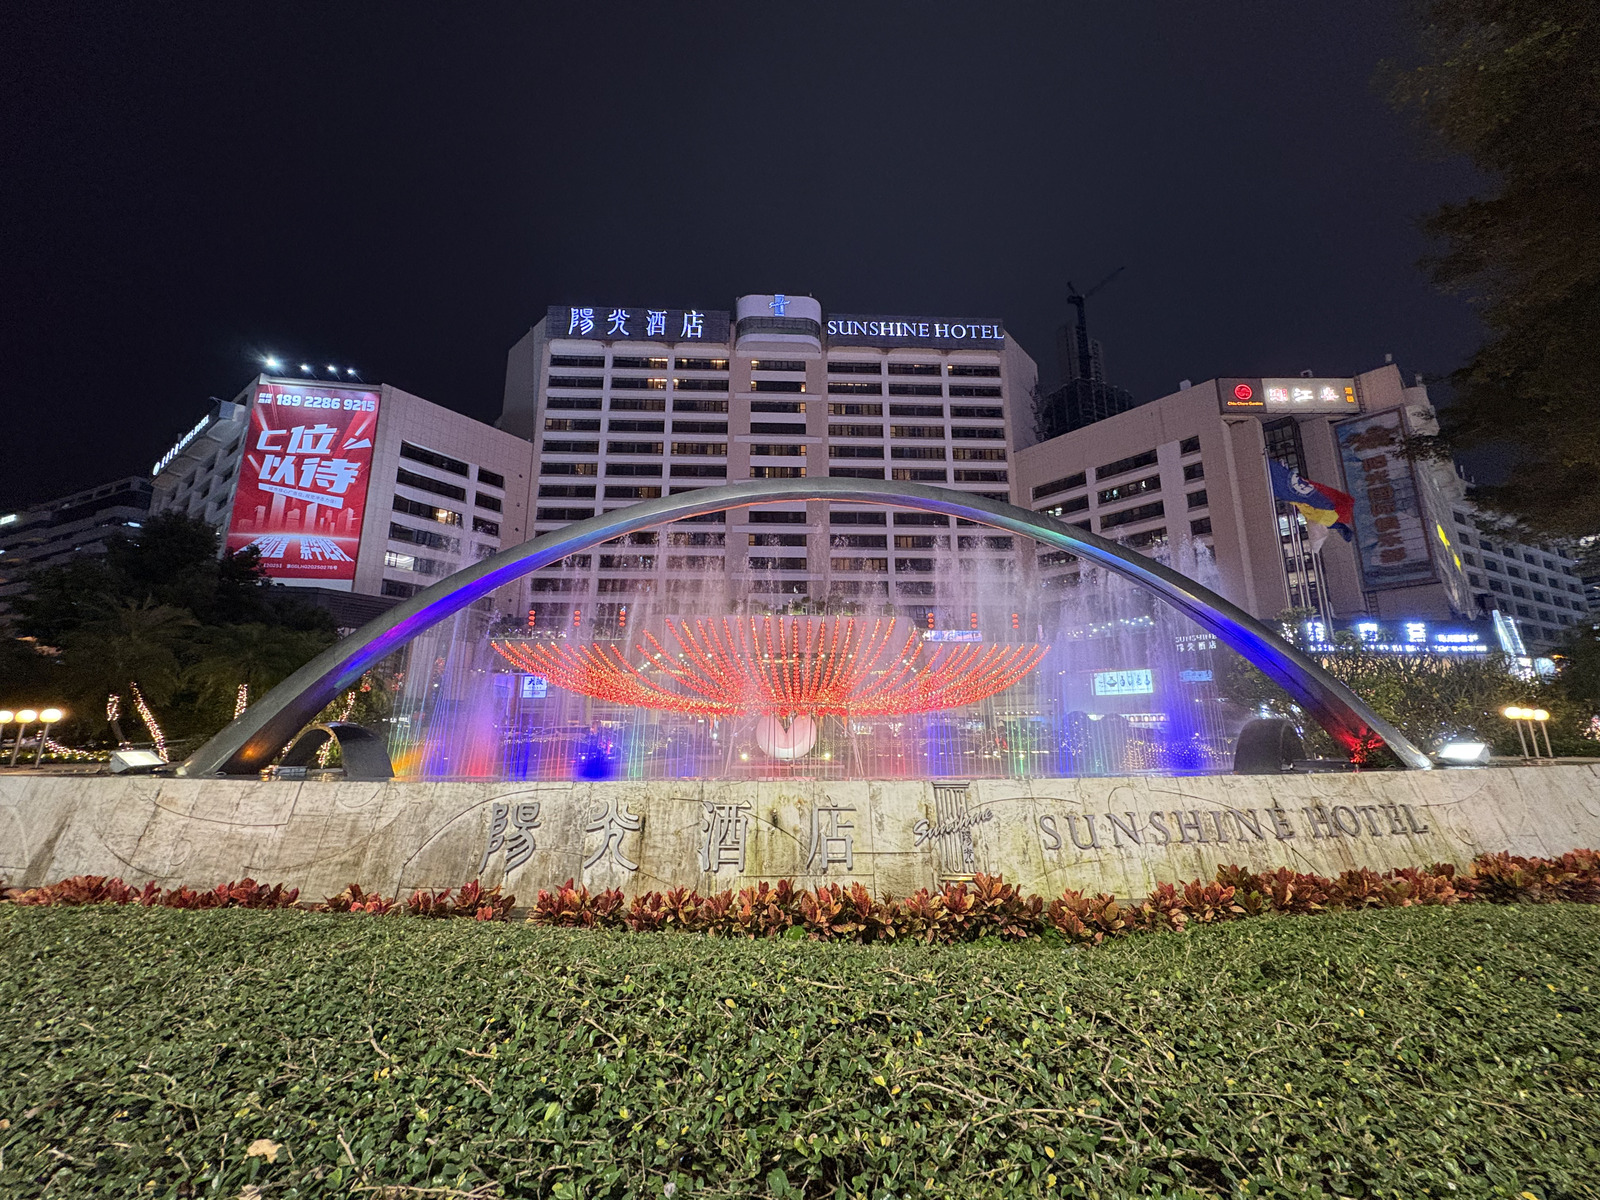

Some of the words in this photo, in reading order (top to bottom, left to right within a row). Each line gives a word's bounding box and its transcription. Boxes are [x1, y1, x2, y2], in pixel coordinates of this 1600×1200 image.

[827, 320, 929, 338] SUNSHINE
[934, 323, 1005, 340] HOTEL
[276, 394, 302, 407] 189
[303, 396, 340, 410] 2286
[343, 398, 376, 412] 9215
[258, 454, 362, 494] 以待
[913, 806, 995, 848] Sunshine
[1038, 806, 1298, 851] SUNSHINE
[1302, 803, 1430, 838] HOTEL
